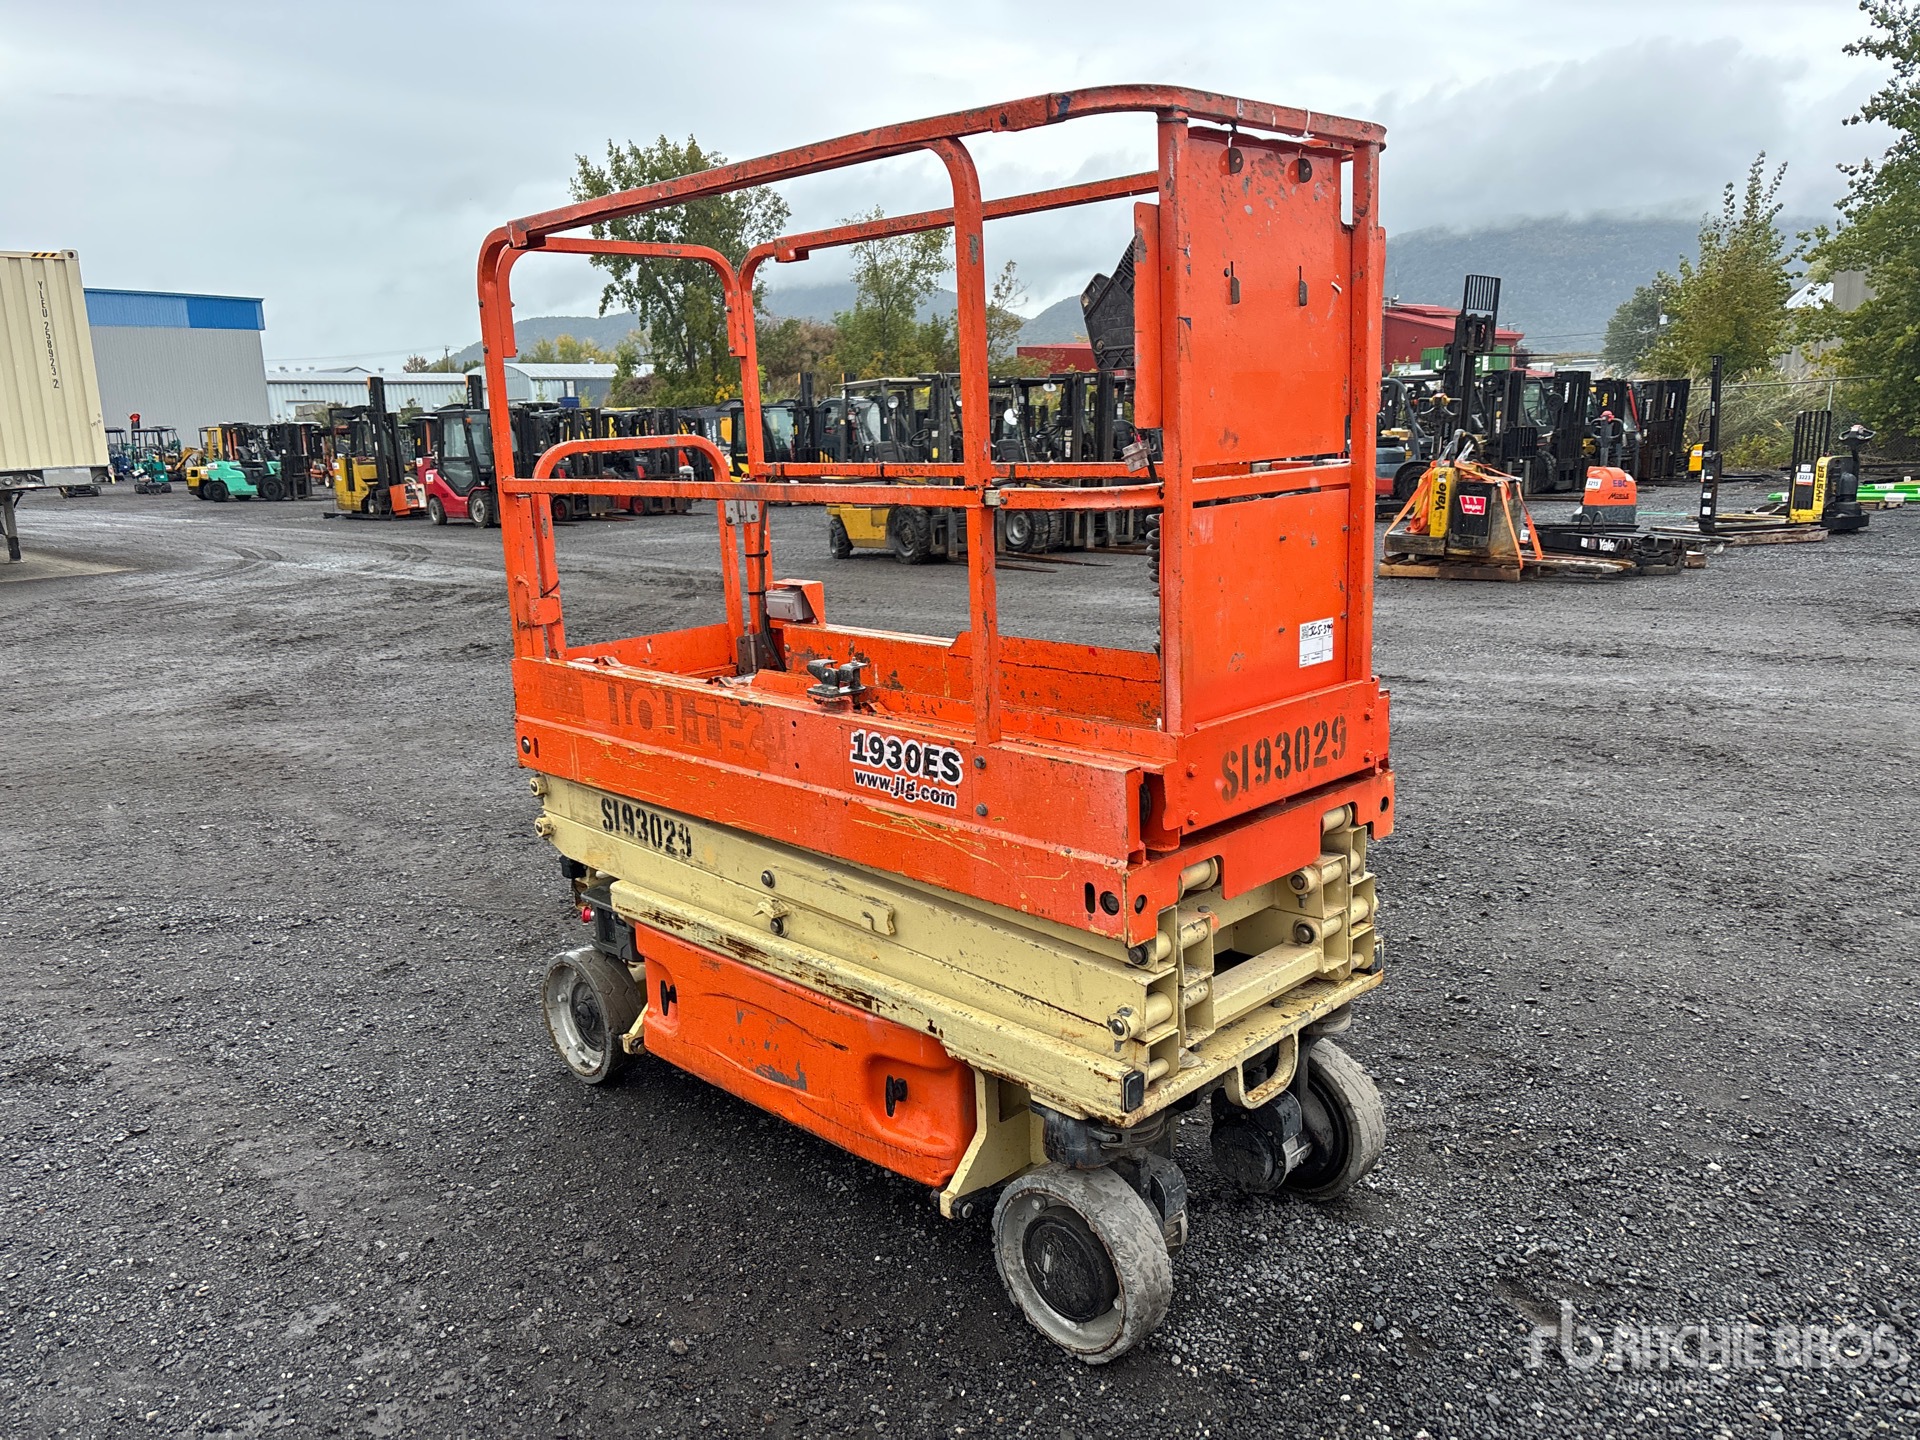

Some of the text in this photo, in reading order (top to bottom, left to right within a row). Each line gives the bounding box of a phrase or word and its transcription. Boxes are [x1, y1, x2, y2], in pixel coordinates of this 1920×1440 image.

[1435, 482, 1447, 511] Yale
[1816, 465, 1825, 502] HYSTER
[1599, 538, 1615, 551] Yale
[850, 731, 962, 784] 1930ES
[854, 770, 956, 807] www.jlg.com
